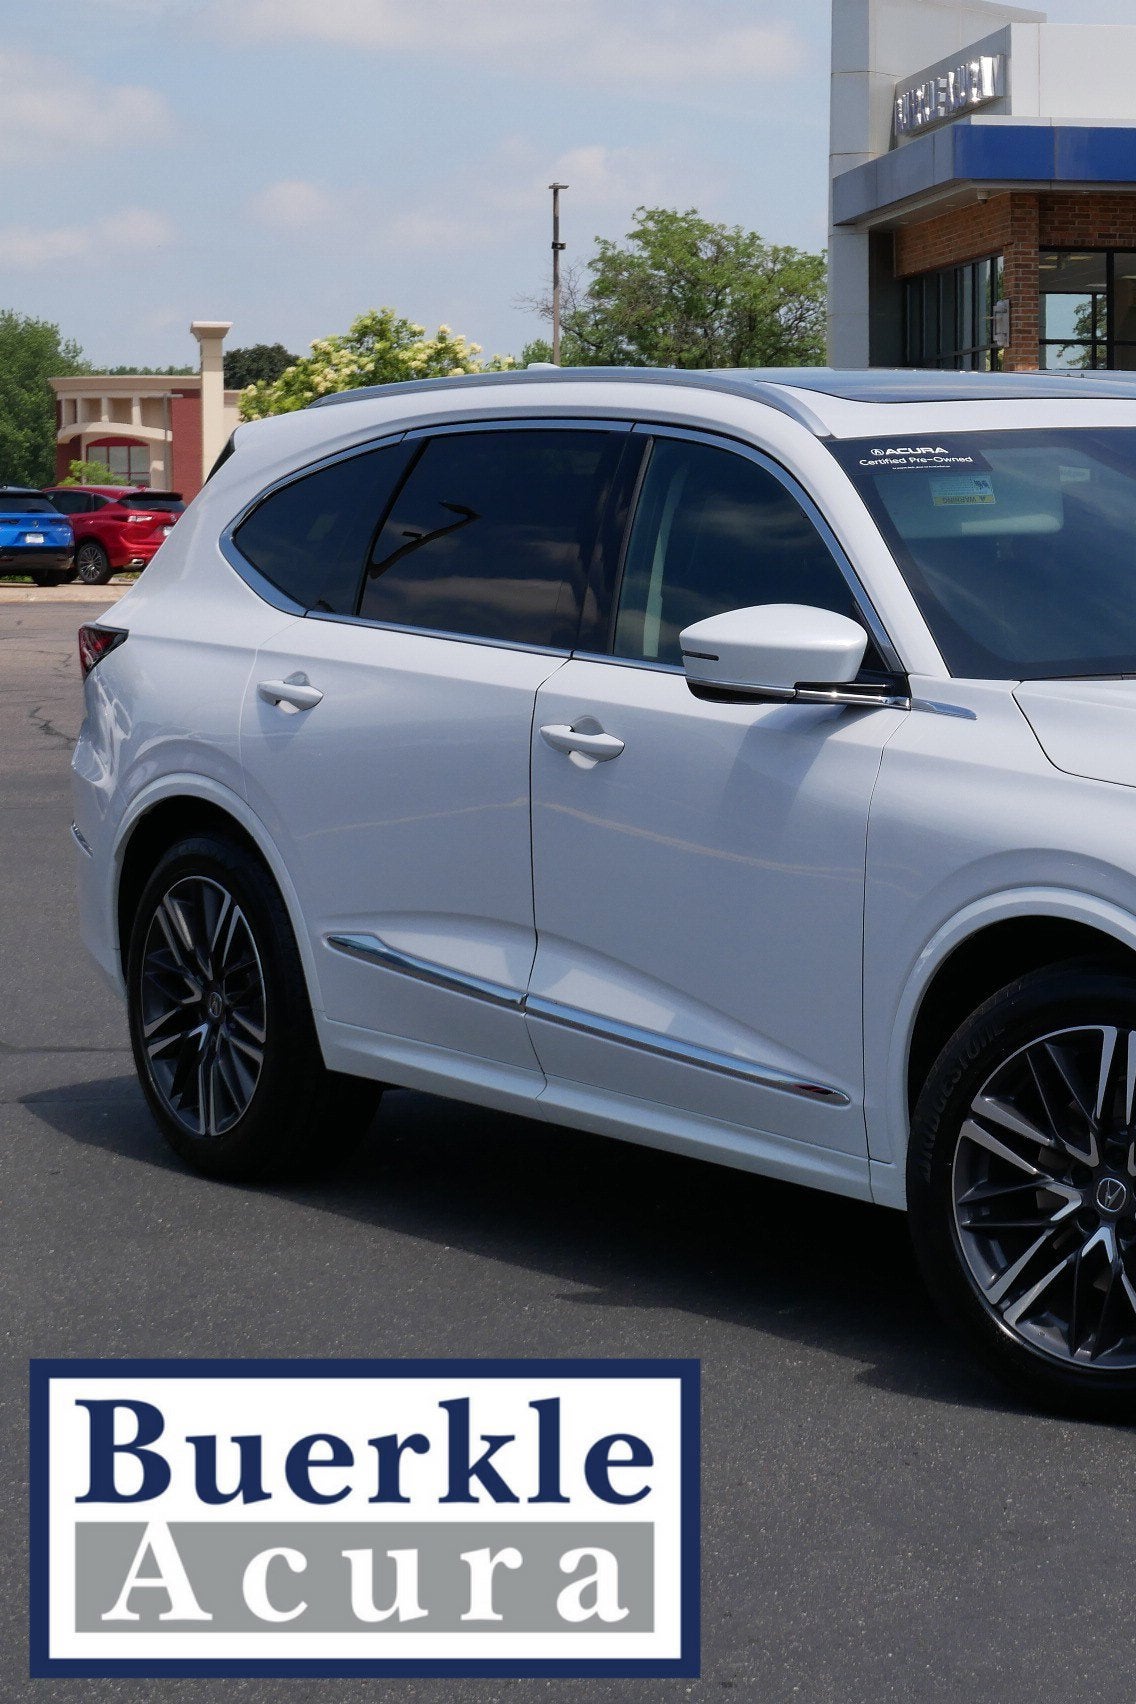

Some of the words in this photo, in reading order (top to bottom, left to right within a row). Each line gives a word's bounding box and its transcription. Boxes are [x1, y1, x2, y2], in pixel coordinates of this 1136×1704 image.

[885, 447, 948, 455] ACURA
[859, 456, 907, 466] Certified
[909, 456, 973, 464] Pre-Owned
